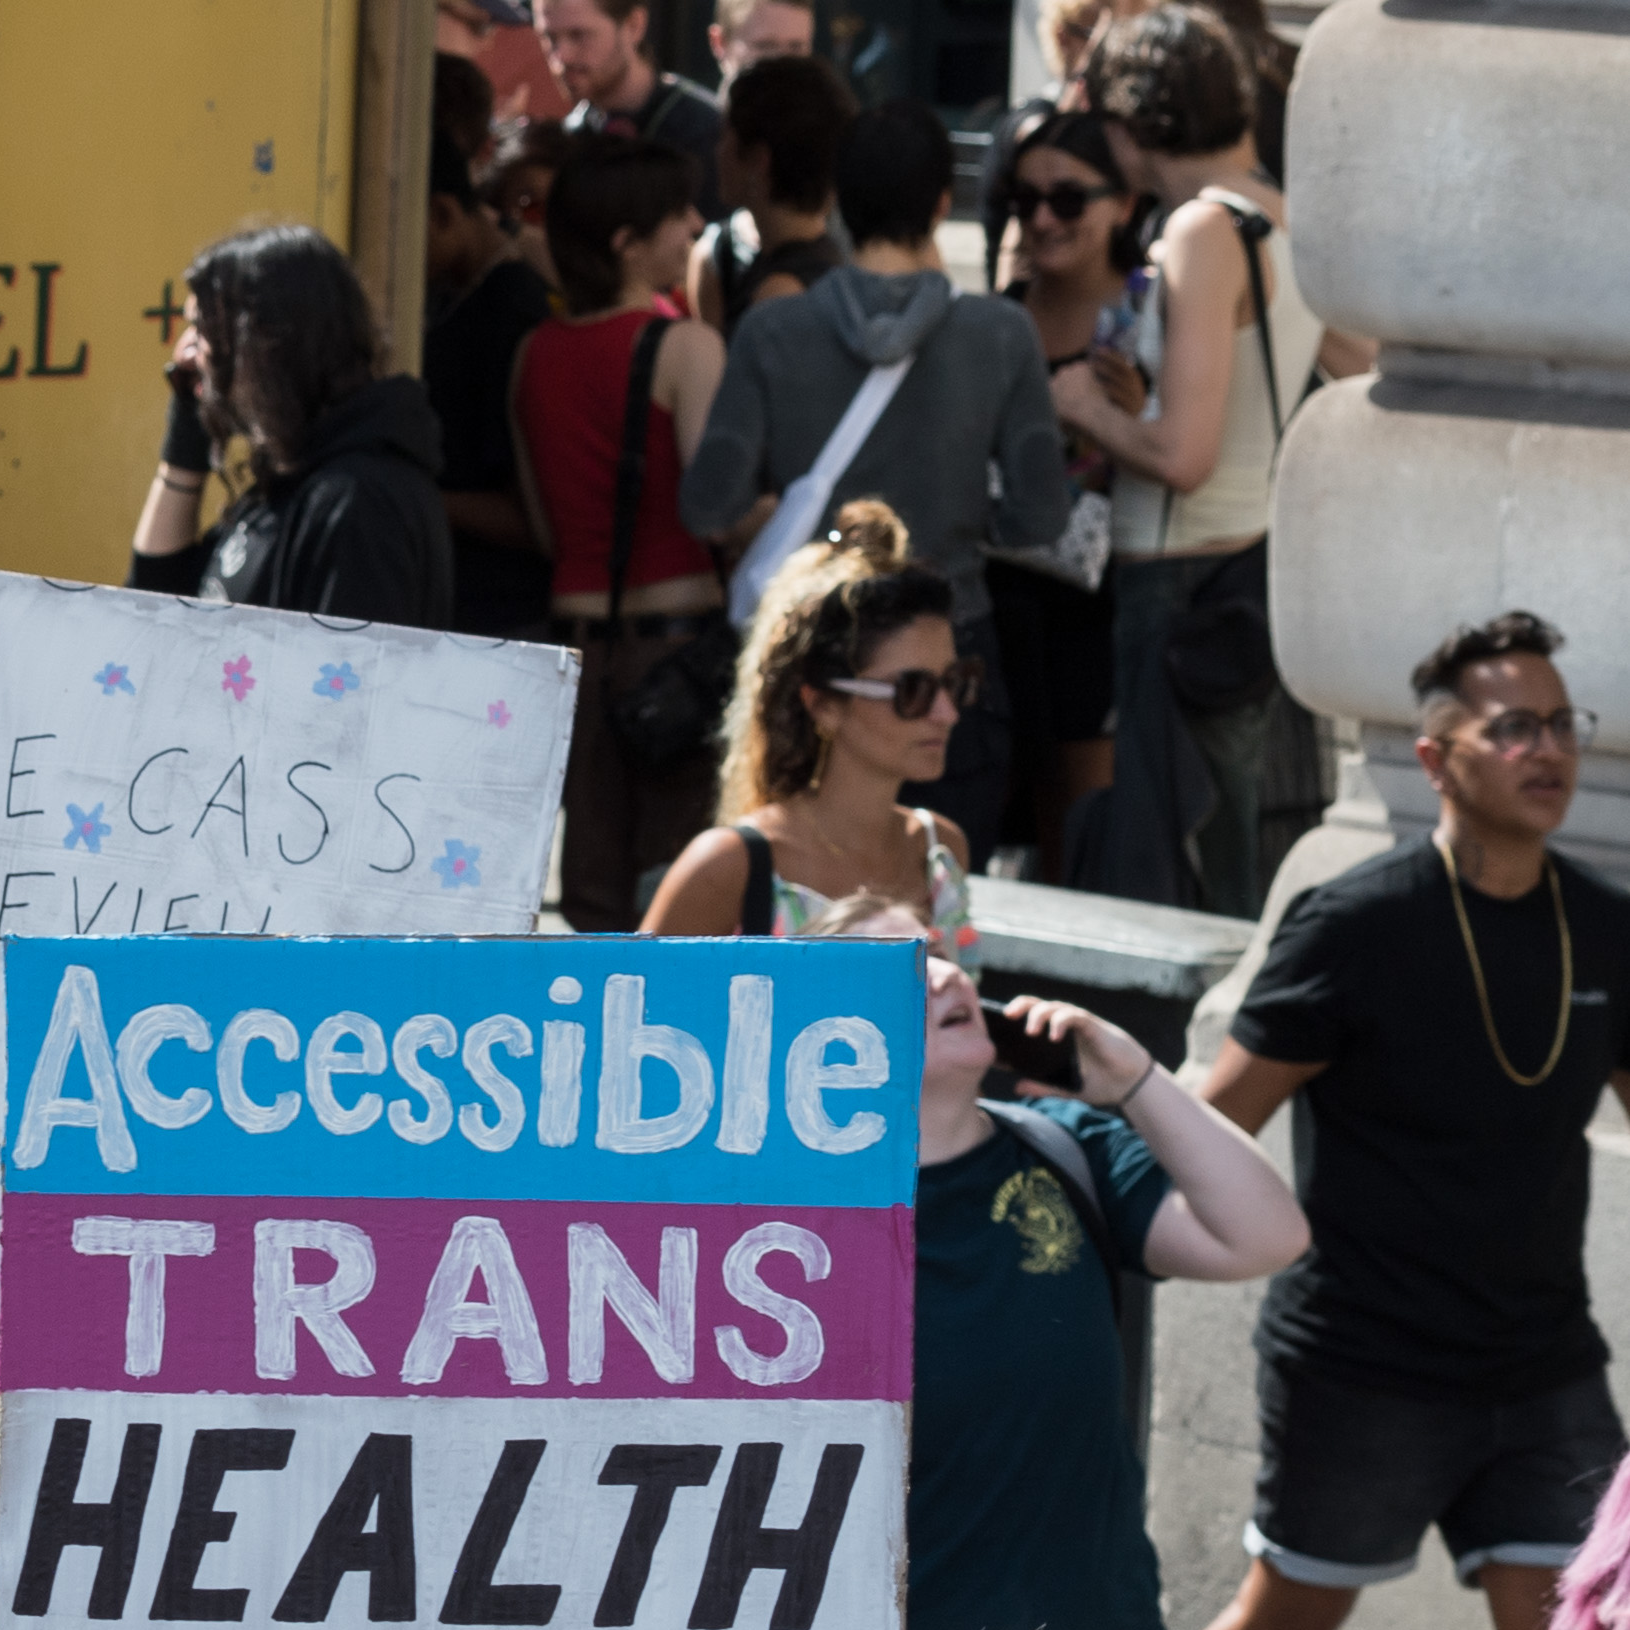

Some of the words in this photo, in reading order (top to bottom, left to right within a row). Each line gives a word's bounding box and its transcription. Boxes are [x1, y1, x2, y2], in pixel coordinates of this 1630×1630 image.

[127, 747, 422, 874] CASS
[12, 963, 891, 1174] Accessible
[70, 1214, 832, 1386] TRANS
